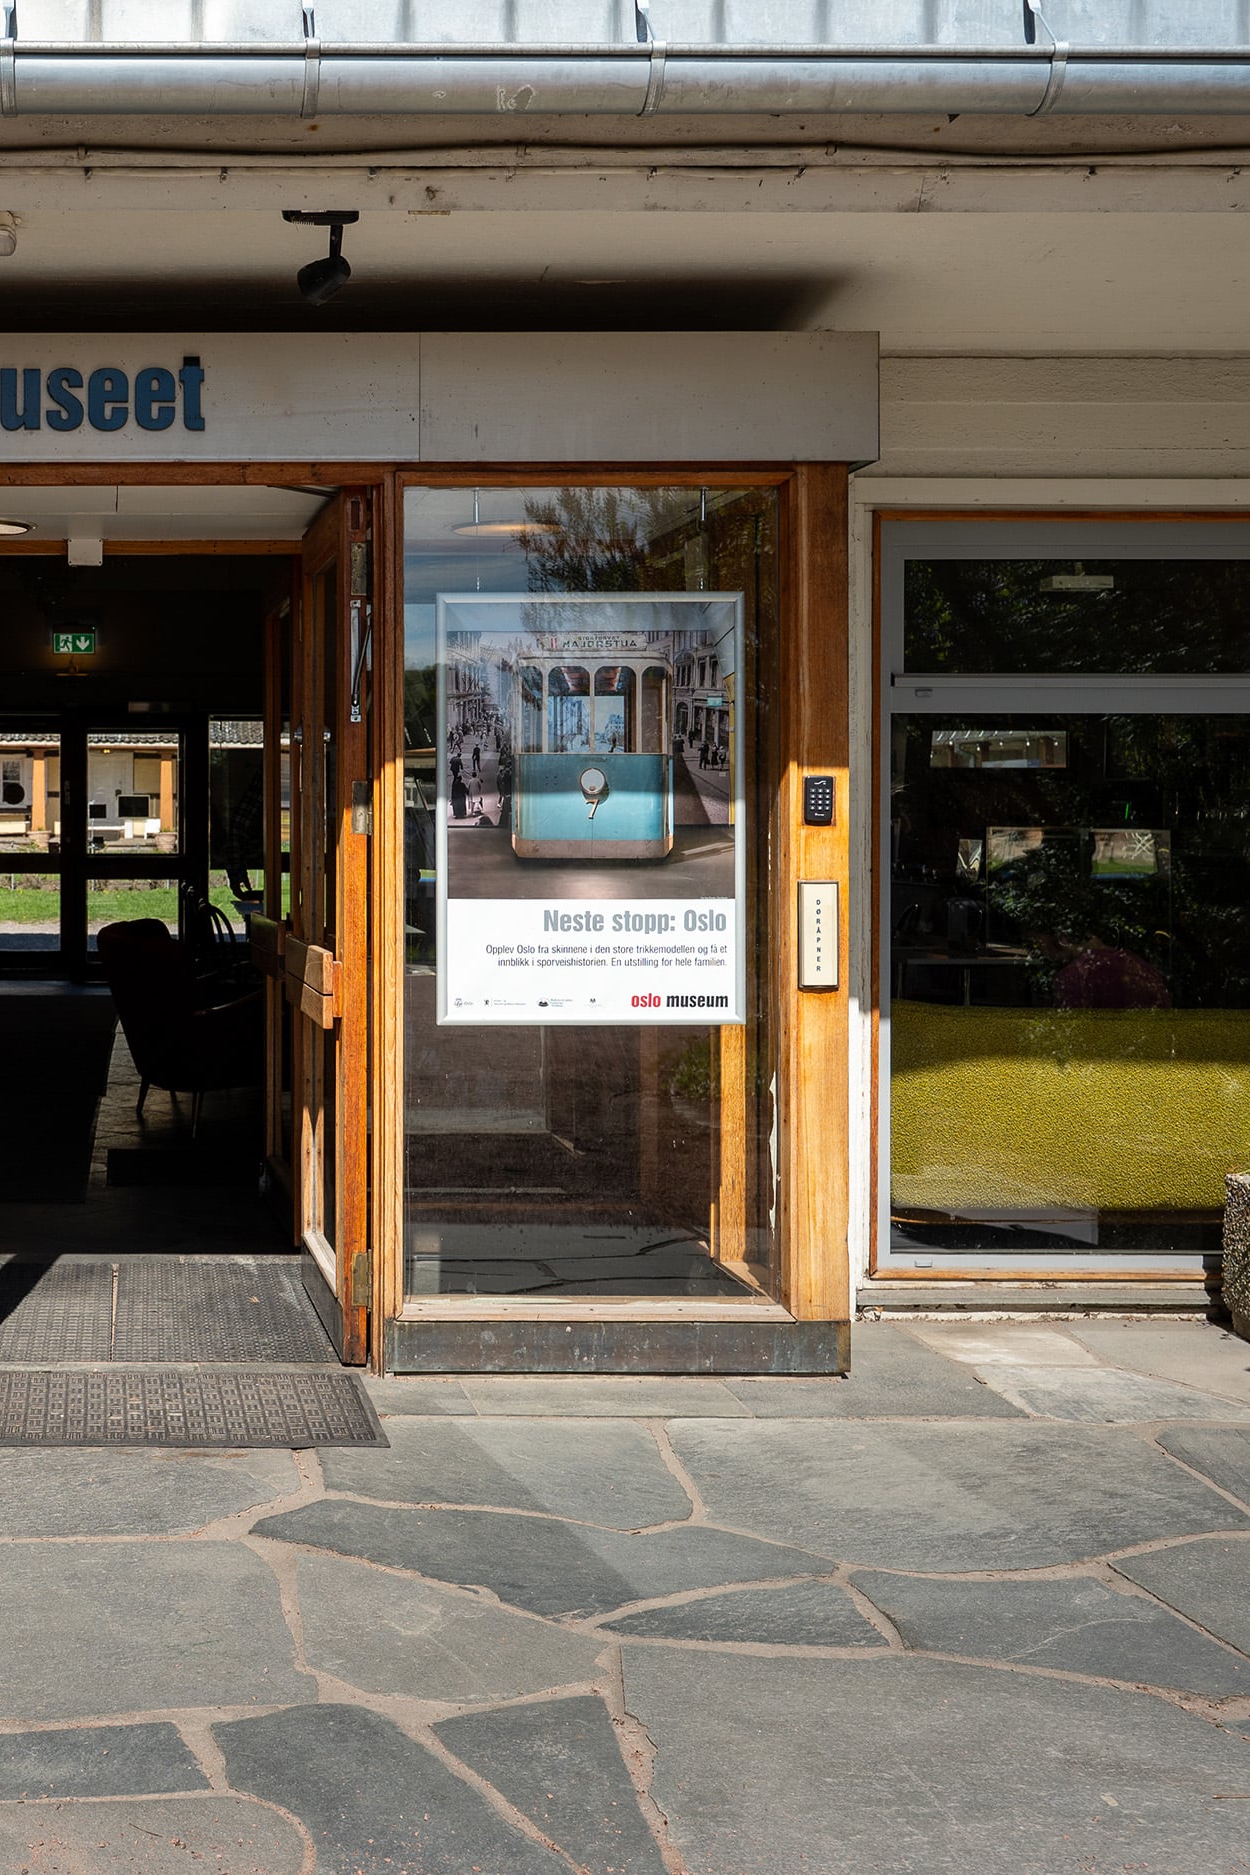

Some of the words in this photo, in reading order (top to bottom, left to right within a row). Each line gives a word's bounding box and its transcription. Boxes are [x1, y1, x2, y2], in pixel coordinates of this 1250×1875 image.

[562, 640, 638, 648] MAJORSTUA
[585, 799, 598, 820] 7
[543, 910, 604, 932] Neste
[612, 911, 676, 934] stopp:
[683, 909, 727, 932] Oslo
[486, 945, 514, 957] Opplev
[516, 944, 536, 954] Oslo
[538, 944, 550, 954] fra
[551, 944, 588, 954] skinnene
[595, 944, 610, 954] den
[613, 945, 634, 954] store
[636, 944, 696, 954] trikkemodellen
[698, 946, 708, 956] og
[710, 944, 718, 954] få
[720, 946, 728, 954] et
[498, 958, 530, 967] innblikk
[537, 958, 608, 968] sporveishistorien.
[611, 958, 622, 967] En
[624, 958, 659, 968] utstilling
[662, 958, 673, 967] for
[675, 958, 692, 967] hele
[694, 958, 727, 967] familien.
[631, 993, 661, 1008] oslo
[666, 994, 729, 1008] museum
